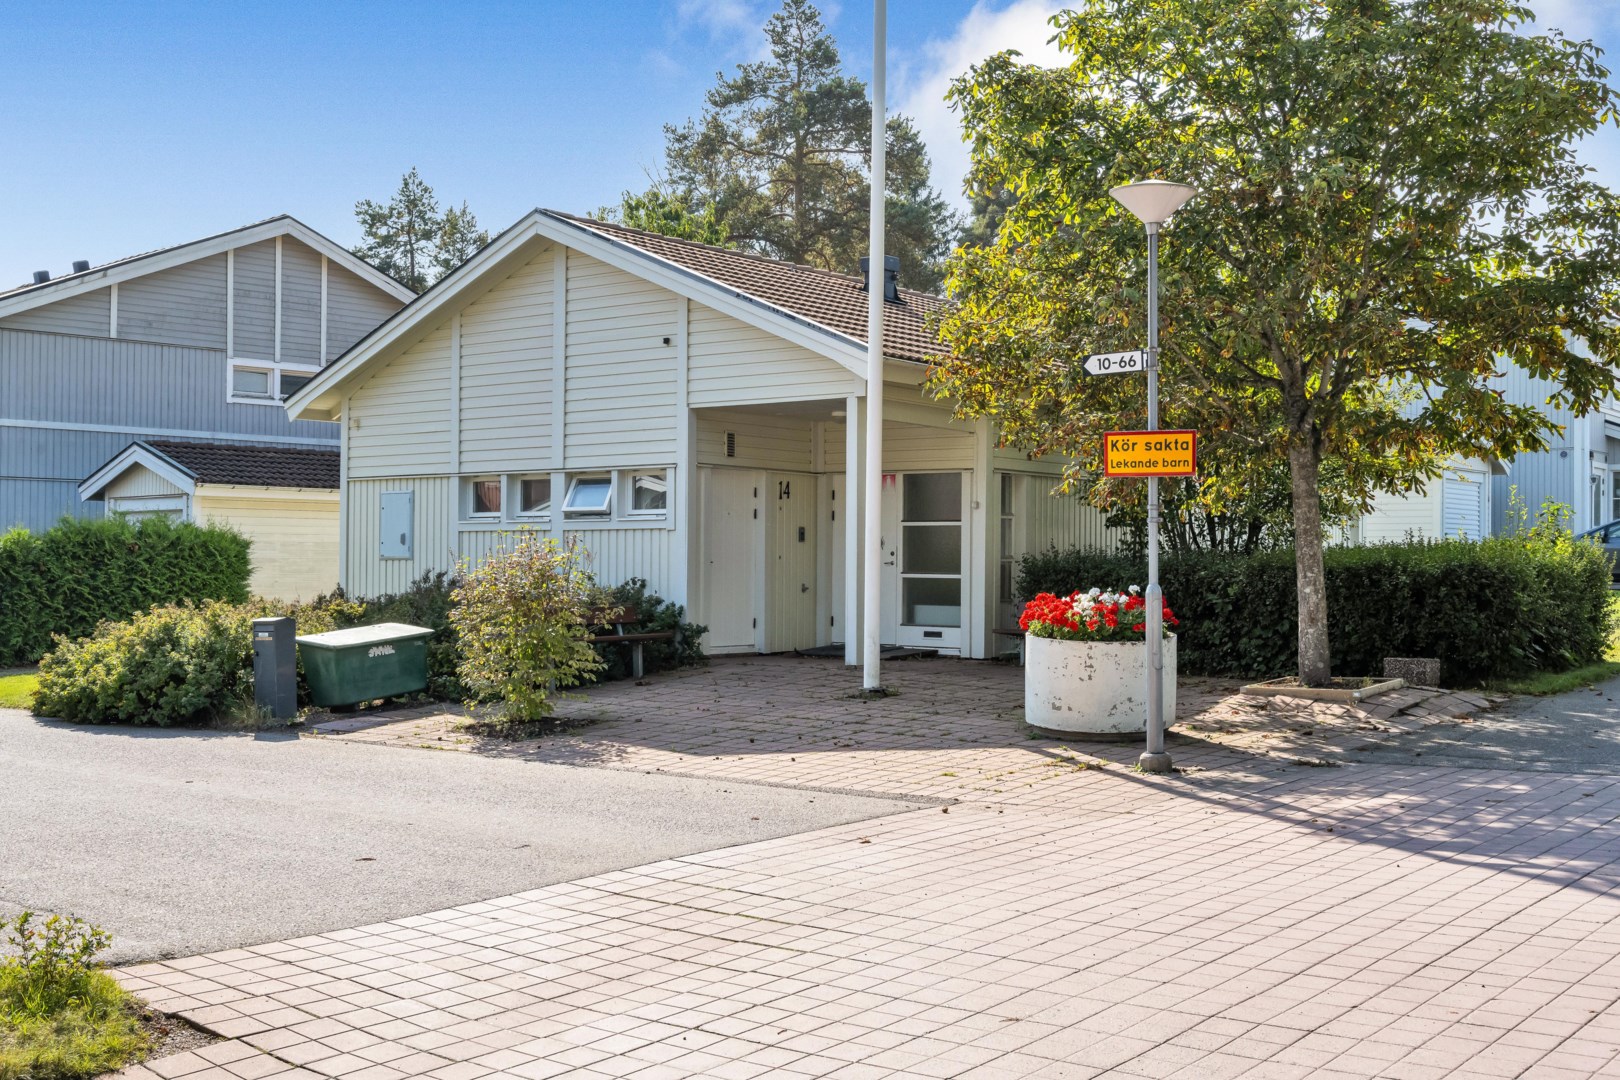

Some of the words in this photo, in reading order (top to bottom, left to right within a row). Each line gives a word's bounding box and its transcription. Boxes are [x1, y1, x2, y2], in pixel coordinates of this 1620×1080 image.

[1096, 355, 1137, 371] 10-66
[1111, 439, 1138, 452] Kör
[1144, 438, 1189, 451] sakta
[1110, 458, 1159, 469] Lekande
[1162, 457, 1190, 468] barn
[778, 480, 791, 500] 14
